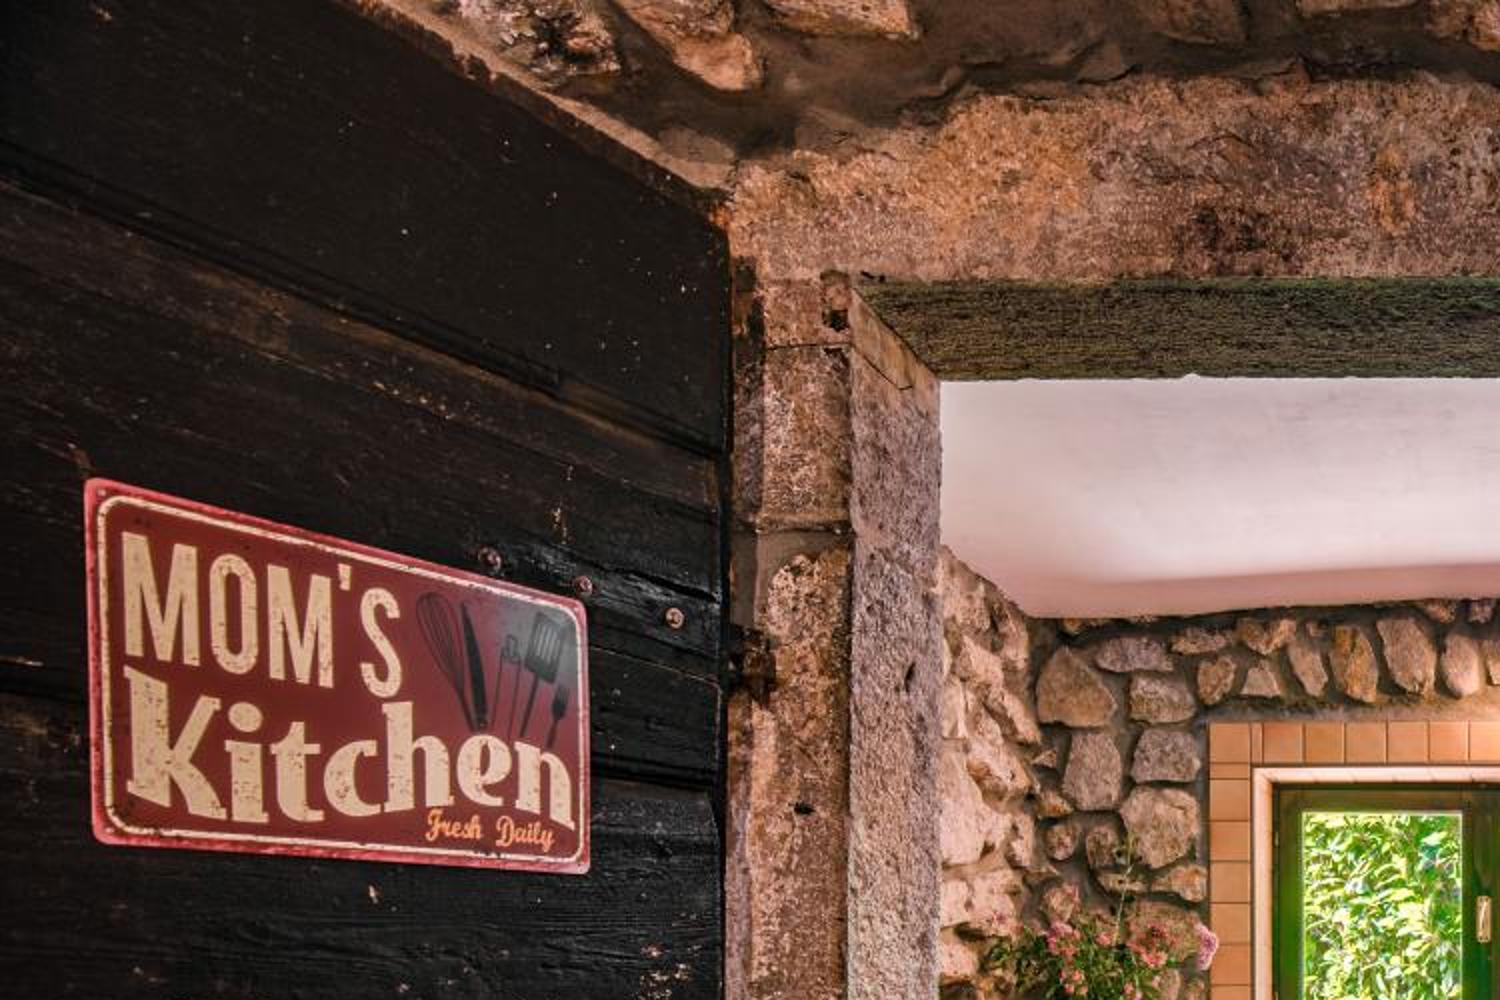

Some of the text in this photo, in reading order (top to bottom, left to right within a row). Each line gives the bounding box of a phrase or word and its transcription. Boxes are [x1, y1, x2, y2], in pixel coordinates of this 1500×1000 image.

[121, 530, 402, 698] MOM'S
[123, 665, 575, 831] Kitchen
[425, 808, 556, 852] Fresh Daily
